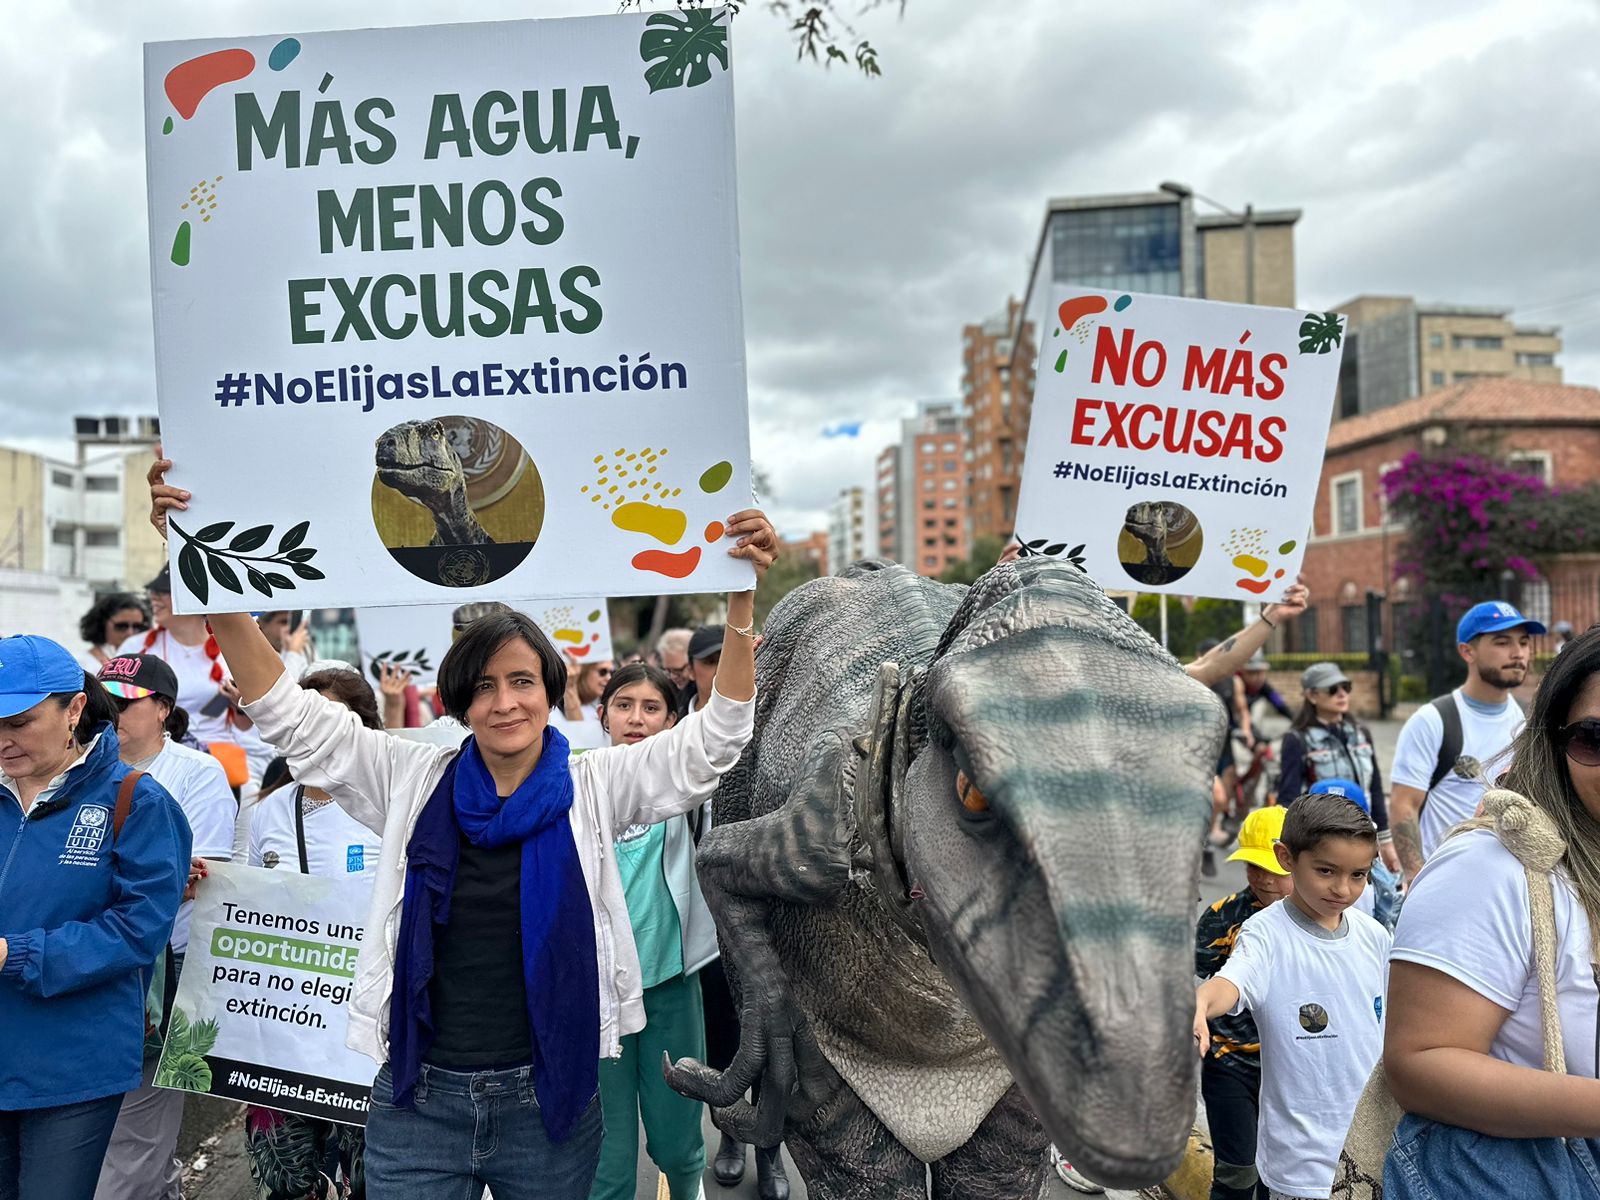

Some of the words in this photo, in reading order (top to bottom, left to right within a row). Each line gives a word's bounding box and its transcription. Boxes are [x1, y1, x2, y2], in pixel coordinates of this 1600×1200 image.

[234, 72, 397, 172] MÁS
[423, 85, 641, 160] AGUA,
[317, 176, 565, 254] MENOS
[287, 265, 604, 345] EXCUSAS
[214, 352, 688, 413] #NoElijasLaExtinción
[1090, 325, 1168, 388] NO
[1182, 329, 1288, 401] MÁS
[1070, 397, 1288, 463] EXCUSAS
[1053, 460, 1288, 498] #NoElijasLaExtinción
[97, 657, 142, 678] ERÚ
[222, 902, 320, 935] Tenemos
[217, 935, 358, 972] oportunida
[211, 965, 261, 987] para
[267, 974, 295, 992] no
[300, 976, 354, 1005] elegi
[225, 997, 328, 1030] extinción.
[227, 1070, 370, 1113] #NoElijasLaExtinci
